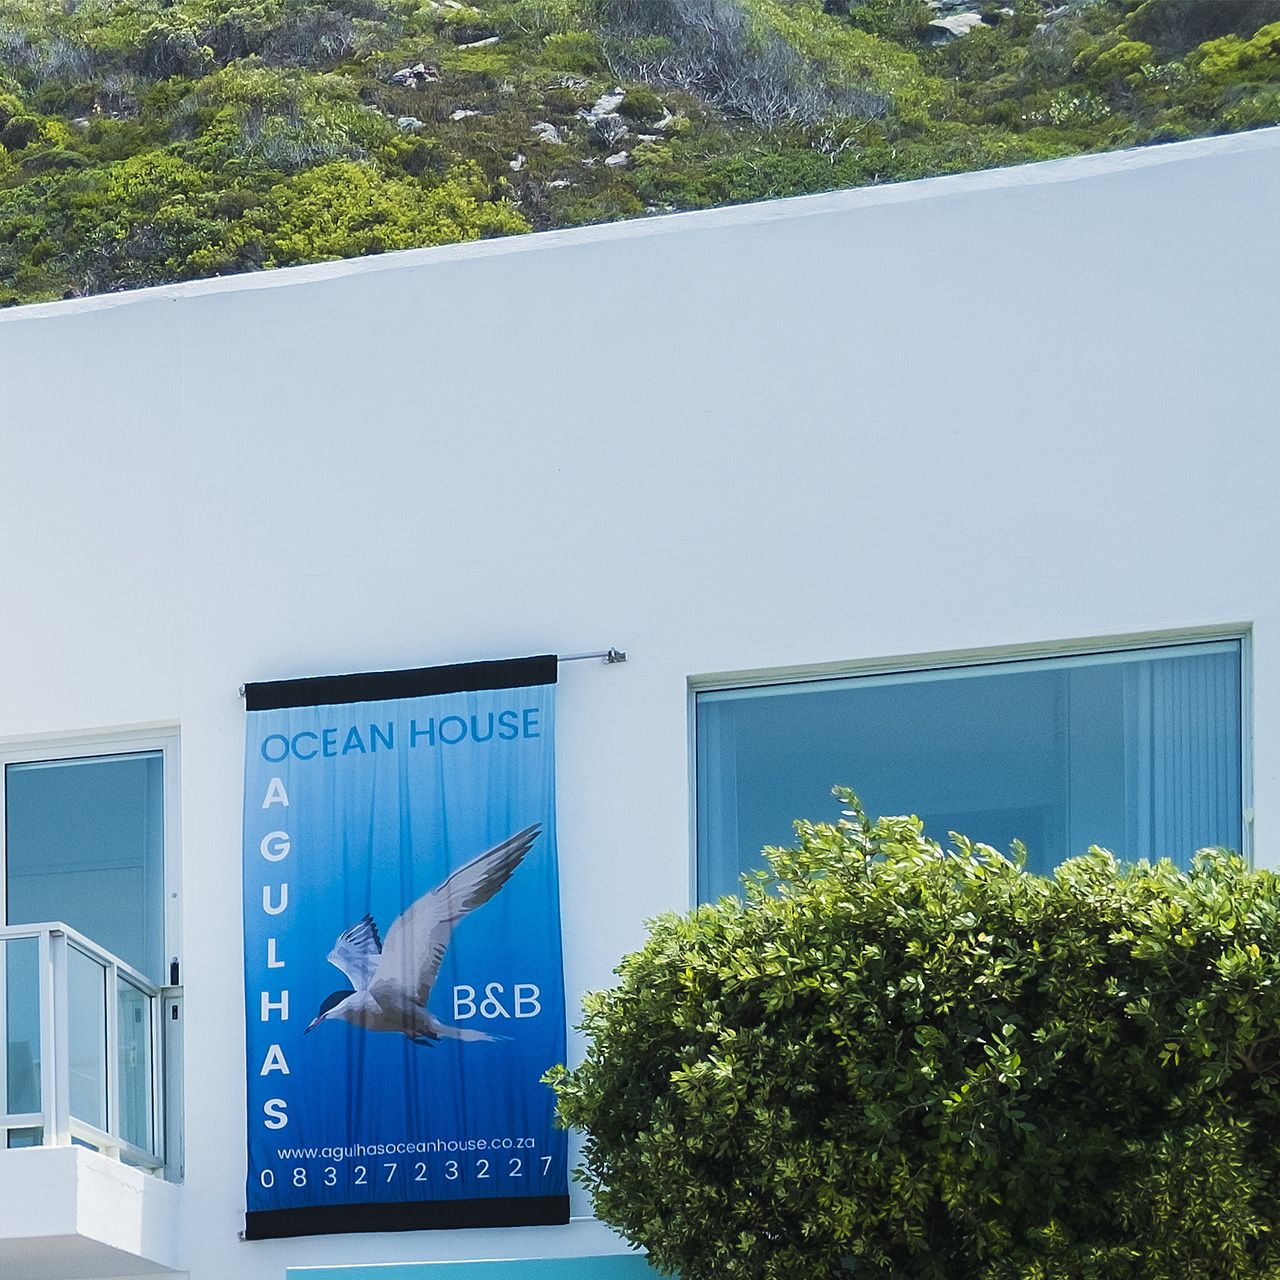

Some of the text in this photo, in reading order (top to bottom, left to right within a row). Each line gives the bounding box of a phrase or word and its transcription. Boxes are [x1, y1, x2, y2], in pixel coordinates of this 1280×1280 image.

[261, 708, 541, 763] OCEAN HOUSE
[259, 777, 291, 1131] AGULHAS
[453, 983, 542, 1020] B&B
[277, 1136, 536, 1162] www.agulhasoceanhouse.co.za
